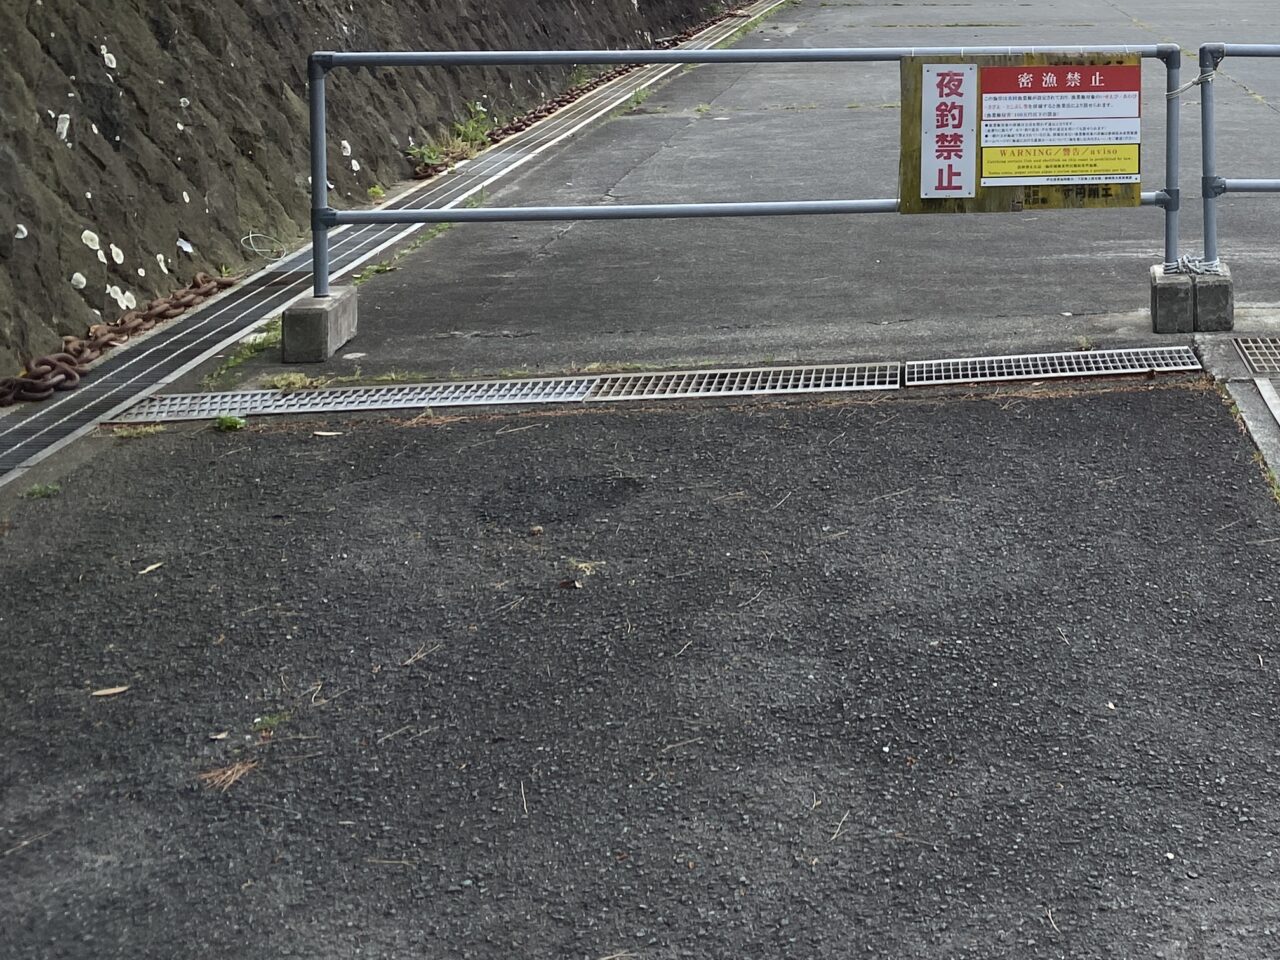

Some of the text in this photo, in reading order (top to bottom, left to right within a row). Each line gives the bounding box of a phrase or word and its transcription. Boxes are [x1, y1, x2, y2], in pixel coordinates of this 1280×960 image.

[1017, 71, 1105, 88] 密漁禁止
[934, 70, 965, 191] 夜釣禁止
